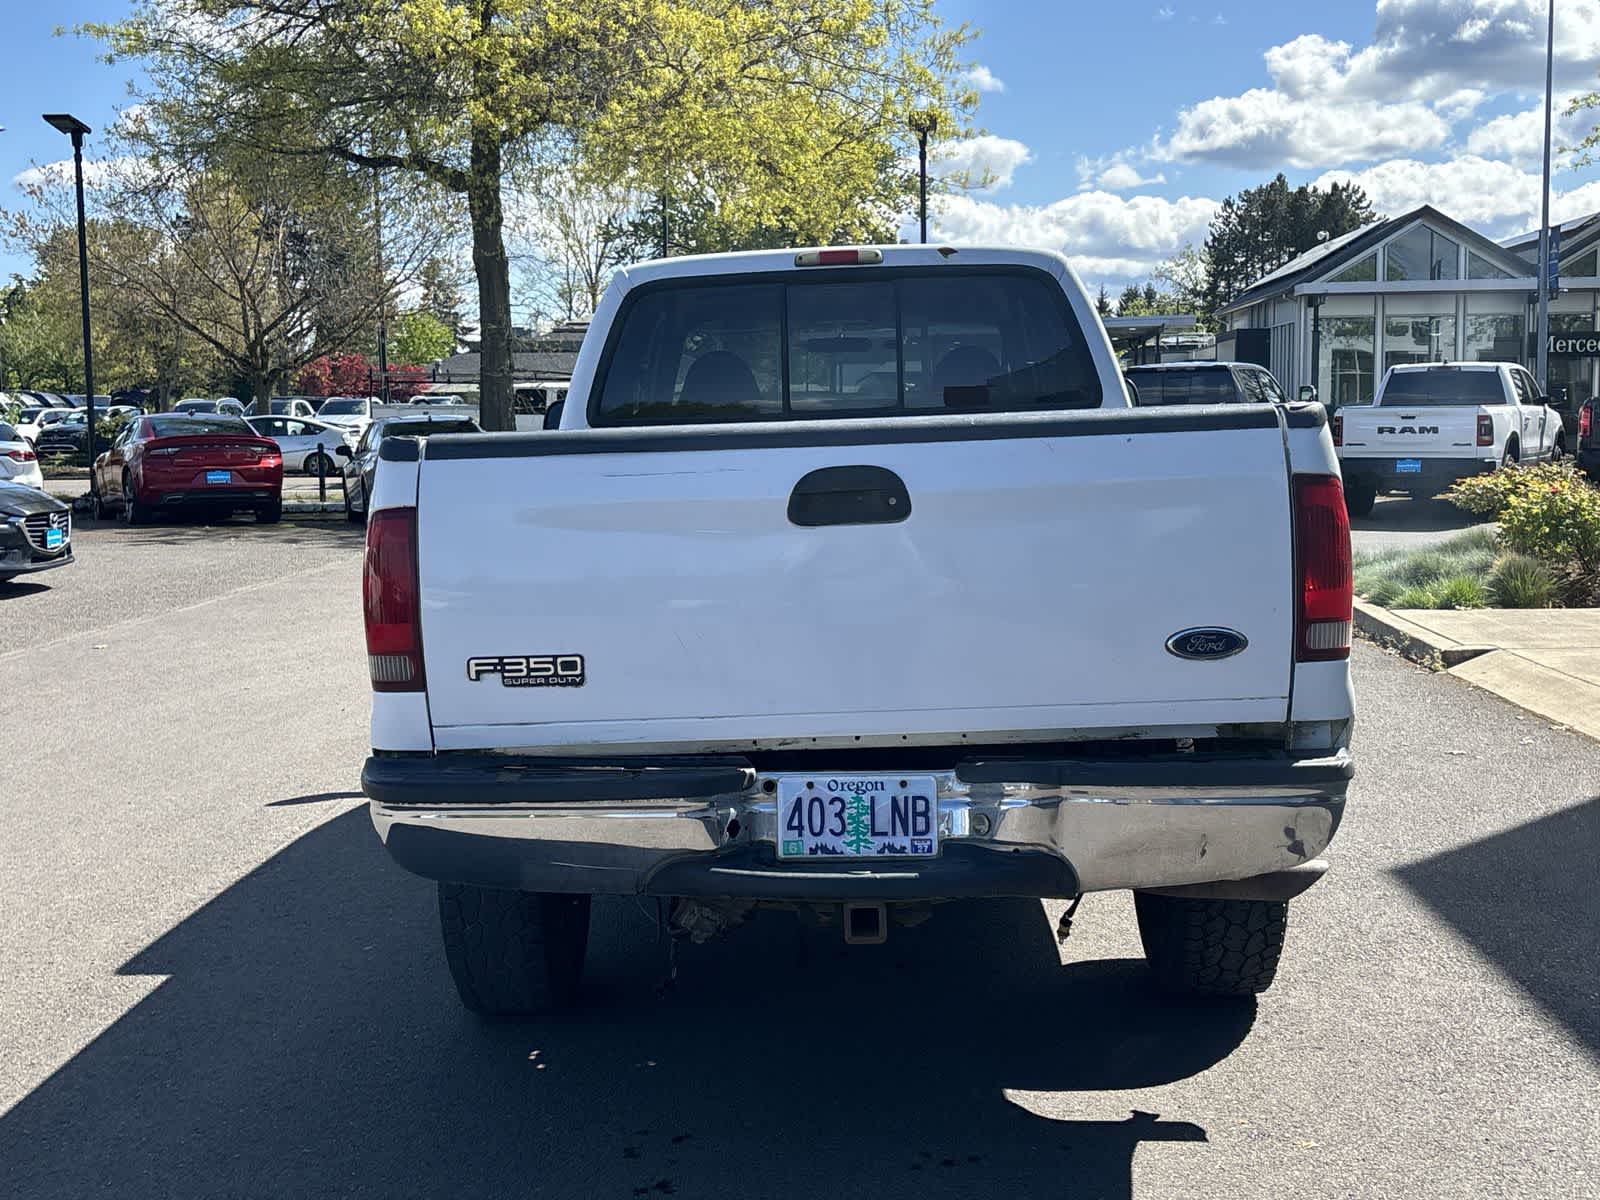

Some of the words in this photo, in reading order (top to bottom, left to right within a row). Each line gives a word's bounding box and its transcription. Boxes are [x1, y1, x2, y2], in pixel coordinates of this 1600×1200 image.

[1377, 426, 1439, 435] RAM
[1186, 634, 1226, 652] Ford
[503, 677, 545, 686] SUPER
[548, 676, 582, 685] DUTY
[827, 779, 885, 795] Oregon
[786, 796, 847, 838] 403
[869, 795, 931, 838] LNB
